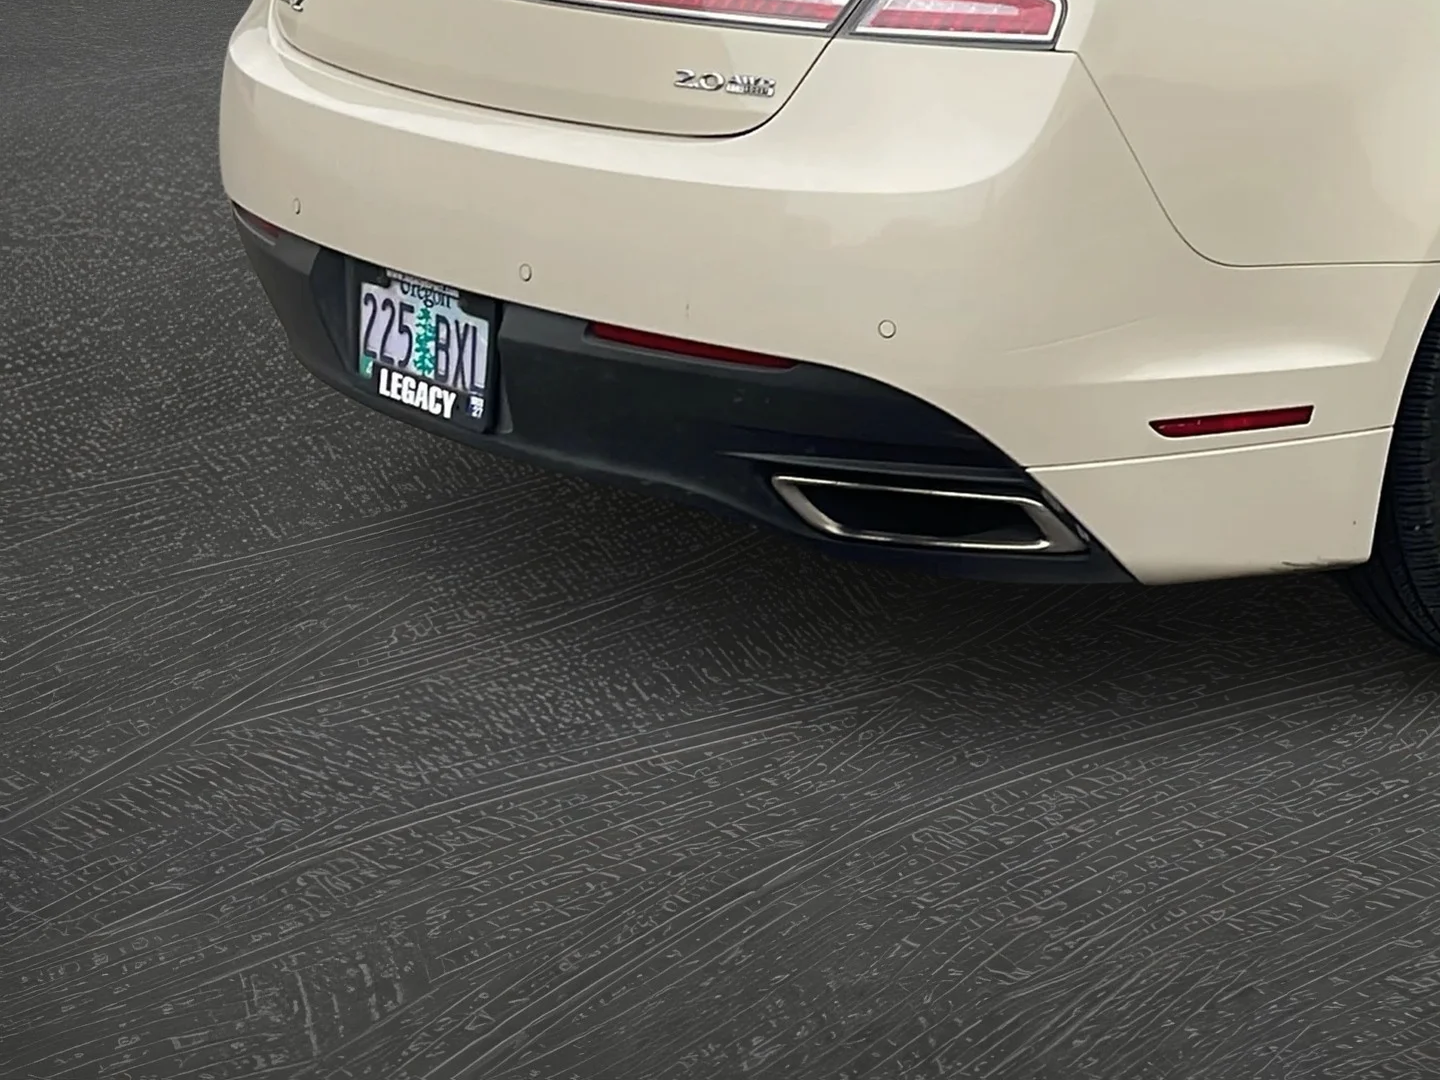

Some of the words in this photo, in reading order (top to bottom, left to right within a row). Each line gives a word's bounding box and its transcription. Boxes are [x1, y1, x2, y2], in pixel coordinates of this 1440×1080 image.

[400, 280, 452, 309] Oregon
[363, 292, 415, 367] 225
[434, 313, 484, 394] BXL
[378, 368, 457, 419] LEGACY
